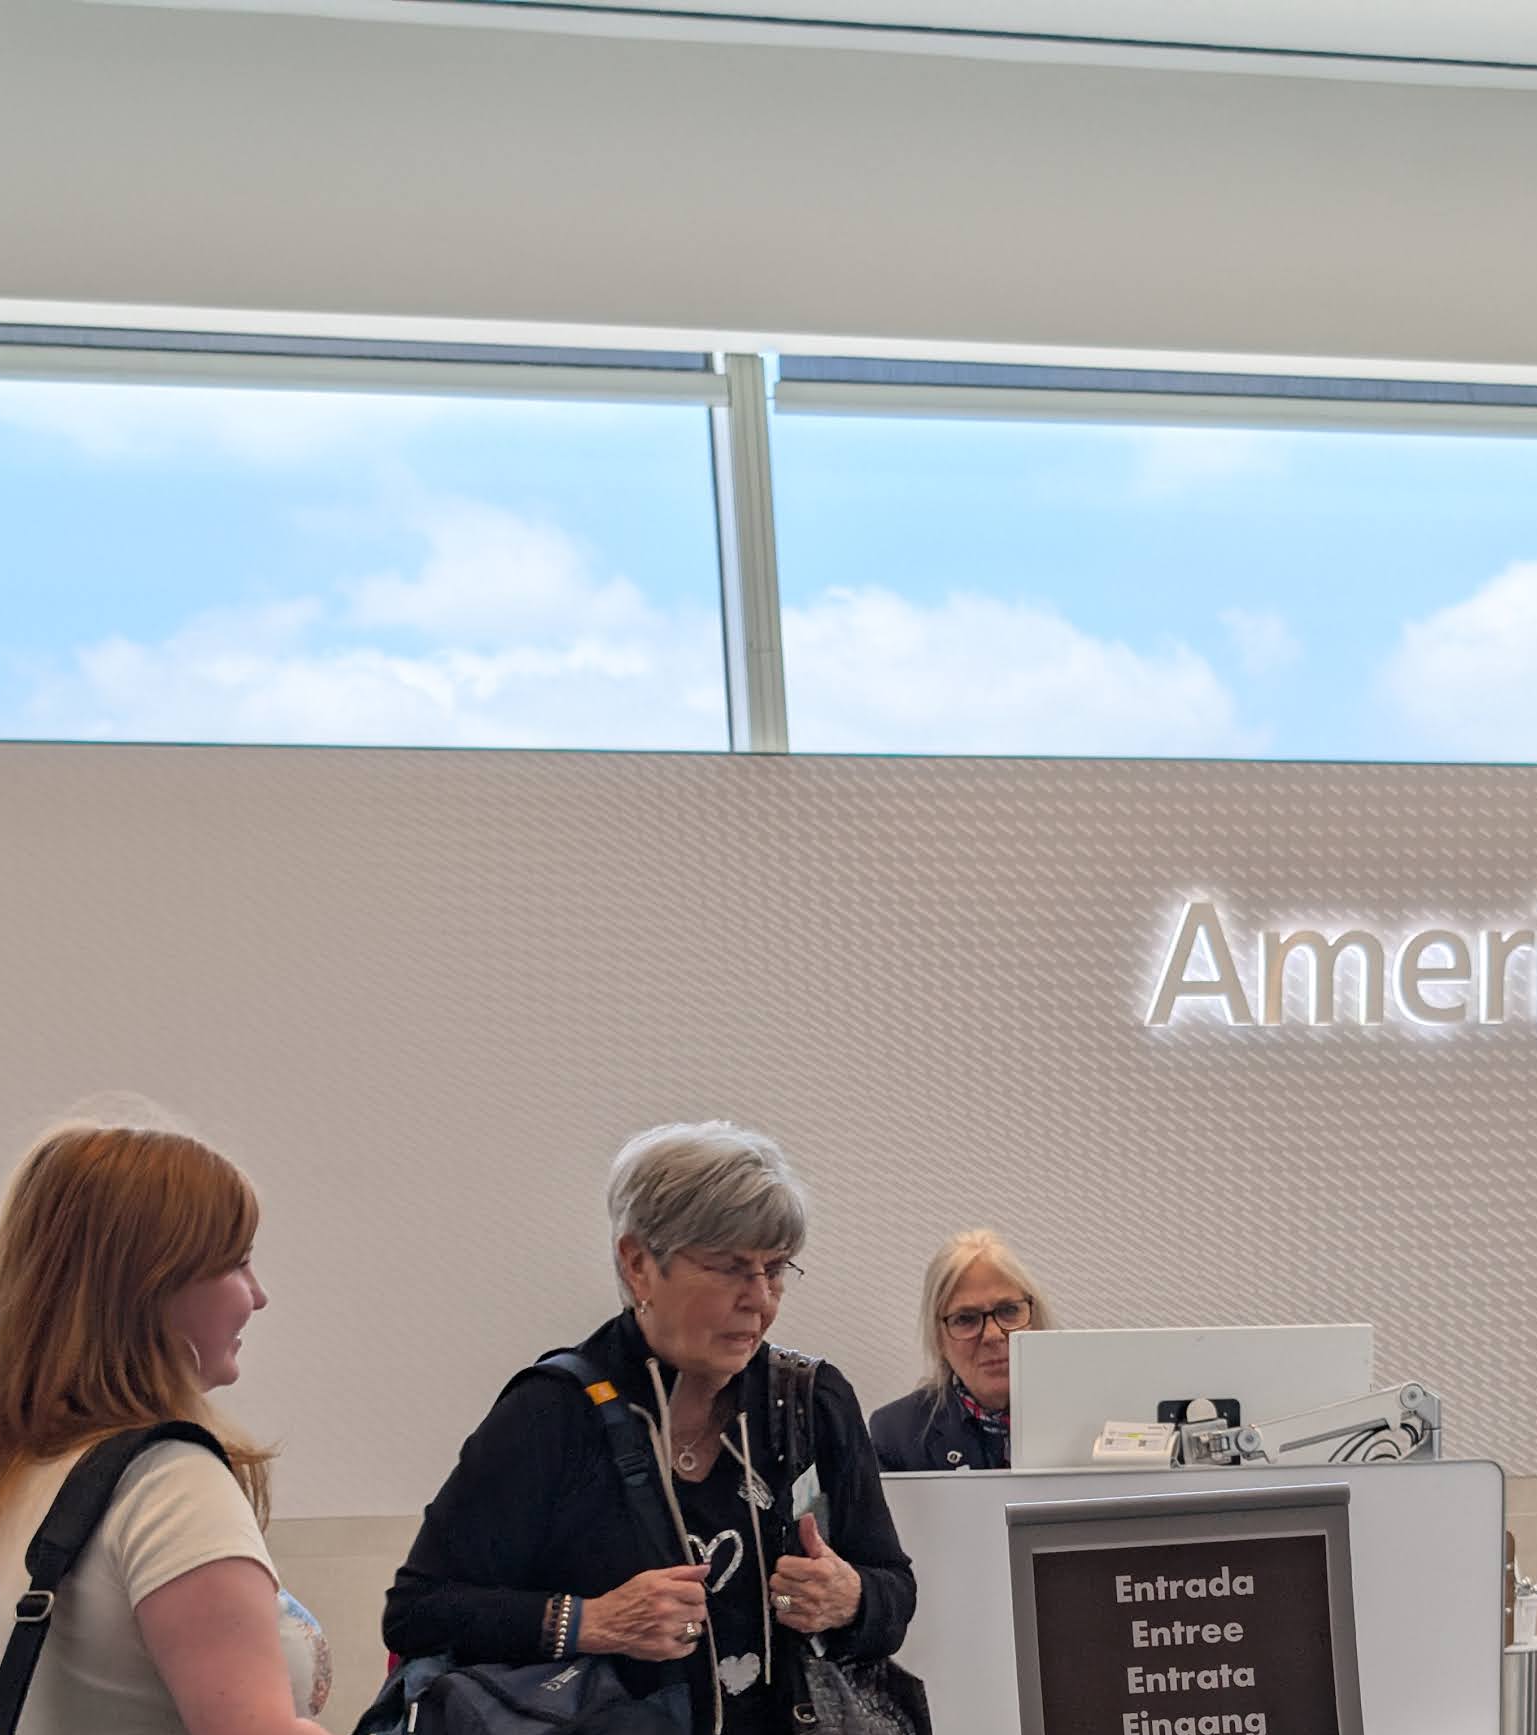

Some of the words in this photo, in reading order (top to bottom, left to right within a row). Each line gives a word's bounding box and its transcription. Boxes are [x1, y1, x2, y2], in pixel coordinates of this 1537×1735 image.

[1115, 1566, 1255, 1603] Entrada
[1131, 1620, 1244, 1648] Entree
[1127, 1664, 1256, 1694] Entrata
